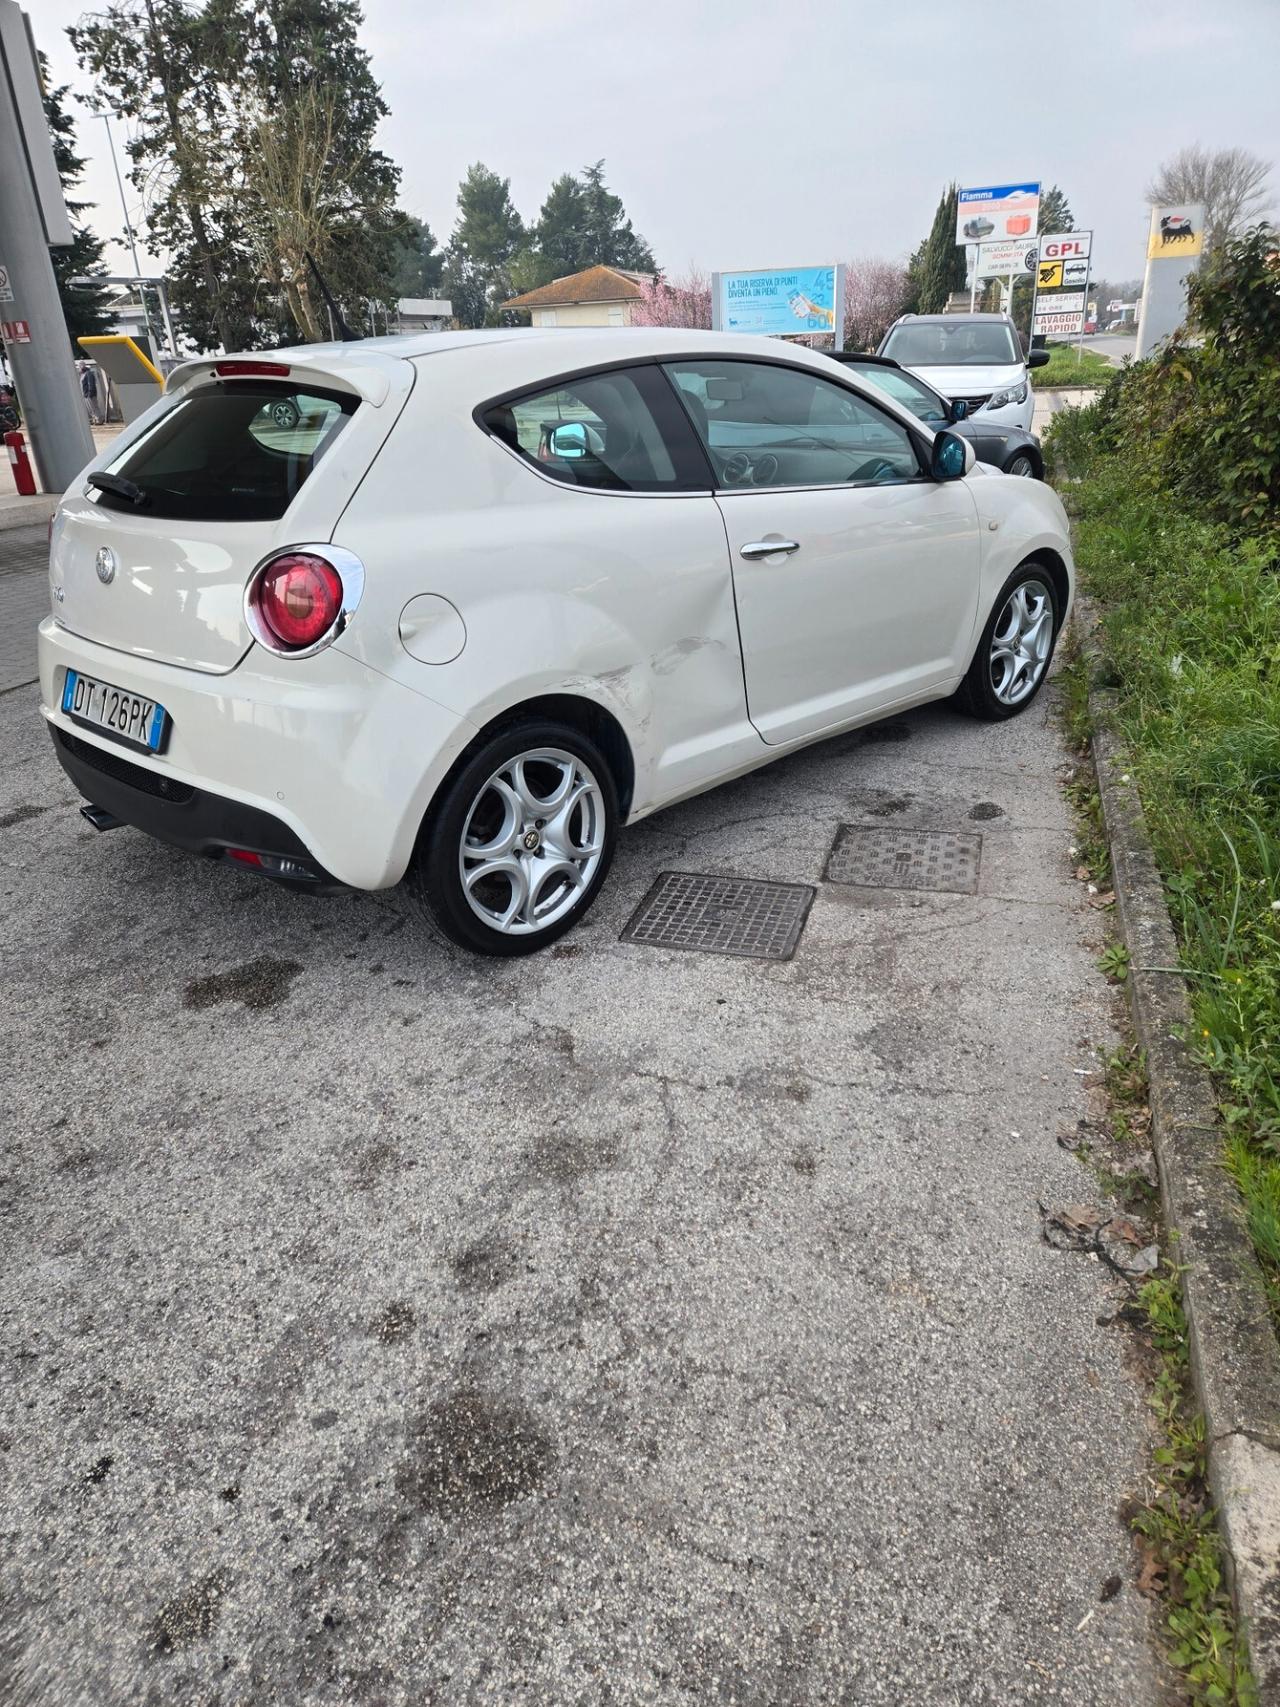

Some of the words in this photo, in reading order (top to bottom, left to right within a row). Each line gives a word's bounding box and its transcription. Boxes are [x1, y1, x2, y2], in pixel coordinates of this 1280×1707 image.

[961, 191, 993, 201] Fiamma
[1045, 242, 1085, 257] GPL
[728, 280, 736, 290] LA
[737, 279, 749, 289] TUA
[750, 278, 773, 288] RISERVA
[781, 276, 797, 286] PUNTI
[728, 288, 752, 299] DIVENTA
[753, 288, 760, 297] UN
[762, 287, 777, 296] PIENO
[1056, 294, 1084, 302] SERVICE
[1035, 313, 1081, 325] LAVAGGIO
[1040, 323, 1077, 333] RAPIDO
[74, 679, 95, 716] DT
[100, 687, 152, 741] 126PK
